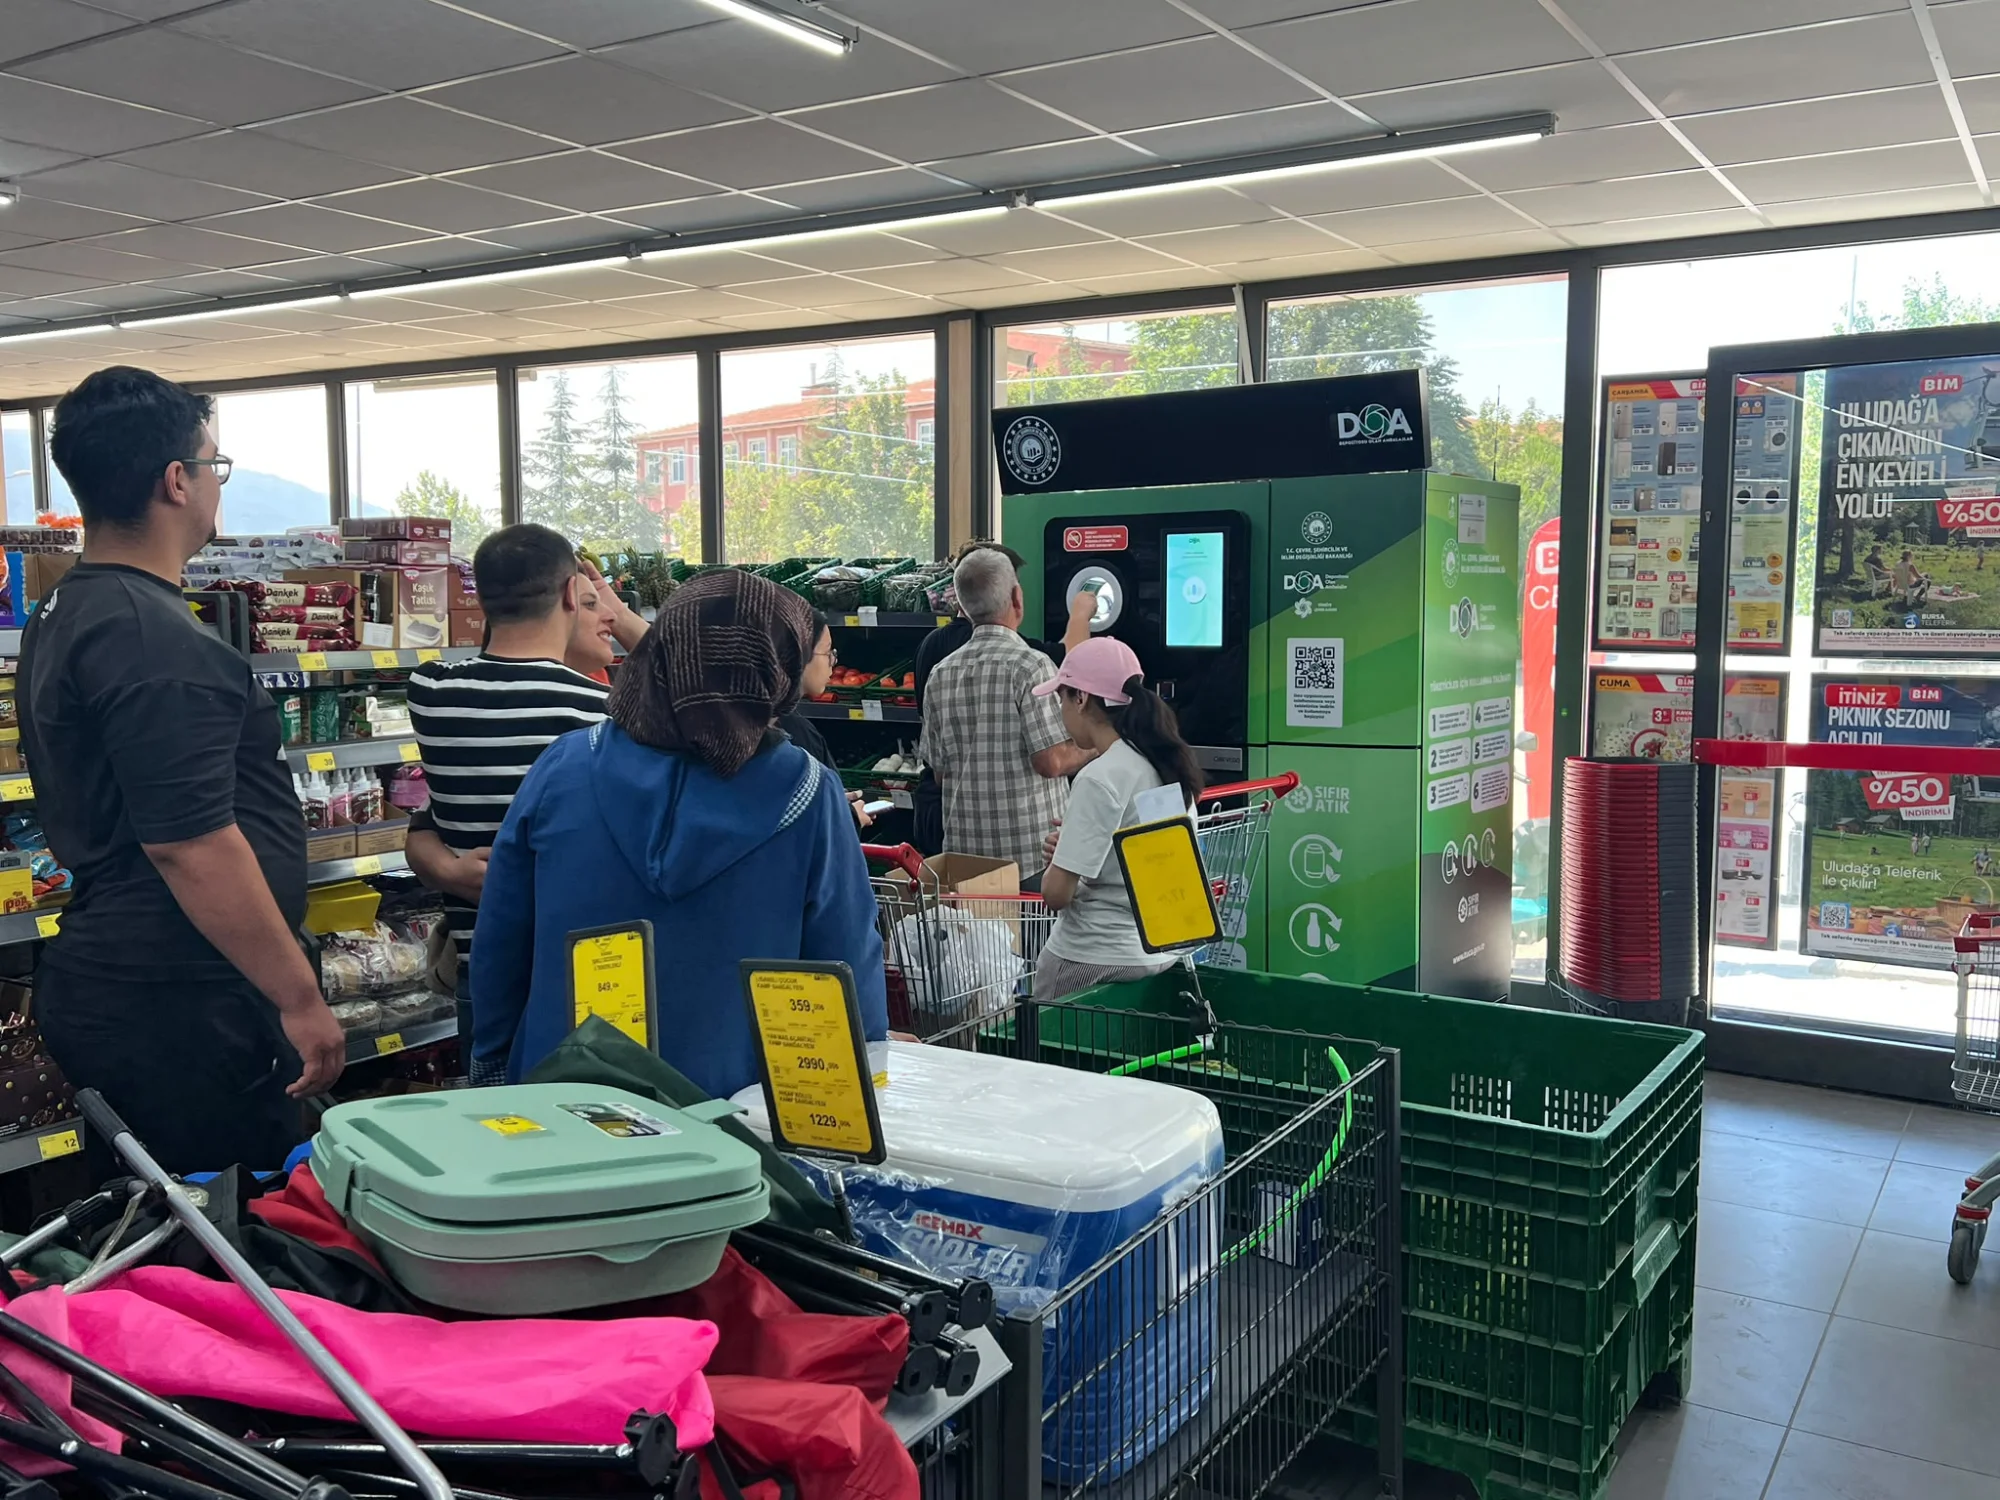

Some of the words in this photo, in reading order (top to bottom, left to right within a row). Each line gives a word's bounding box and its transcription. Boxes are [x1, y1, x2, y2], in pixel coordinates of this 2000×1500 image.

[1924, 376, 1959, 392] BİM
[1838, 395, 1940, 429] ULUDAĞ'A
[1337, 403, 1413, 440] DOA
[1837, 429, 1942, 463] ÇIKMANIN
[1836, 462, 1863, 489] EN
[1868, 455, 1947, 487] KEYİFLİ
[1835, 492, 1893, 519] YOLU!
[1942, 502, 2000, 523] %50
[412, 583, 435, 595] Kaşık
[1283, 570, 1325, 594] DOA
[266, 588, 299, 599] Dankek
[410, 595, 437, 606] Tatlısı
[311, 612, 339, 622] Dankek
[1449, 596, 1480, 640] DOA
[261, 626, 292, 637] Dankek
[271, 645, 301, 653] Dankek
[1599, 680, 1631, 688] CUMA
[1838, 687, 1888, 706] İTİNİZ
[1912, 689, 1940, 700] BİM
[1432, 714, 1437, 732] 1
[1475, 706, 1482, 723] 4
[1884, 708, 1951, 730] SEZONU
[1430, 749, 1438, 768] 2
[1474, 742, 1480, 759] 5
[1315, 786, 1350, 799] SIFIR
[1430, 786, 1437, 804] 3
[1473, 782, 1479, 800] 6
[1868, 778, 1943, 805] %50
[1315, 799, 1350, 814] ATIK
[1905, 807, 1951, 817] İNDİRİMLİ
[1822, 860, 1881, 878] Uludağ'a
[1886, 864, 1942, 881] Teleferik
[1822, 876, 1837, 887] ile
[1839, 877, 1877, 890] çıkılır!
[64, 1138, 77, 1148] 12
